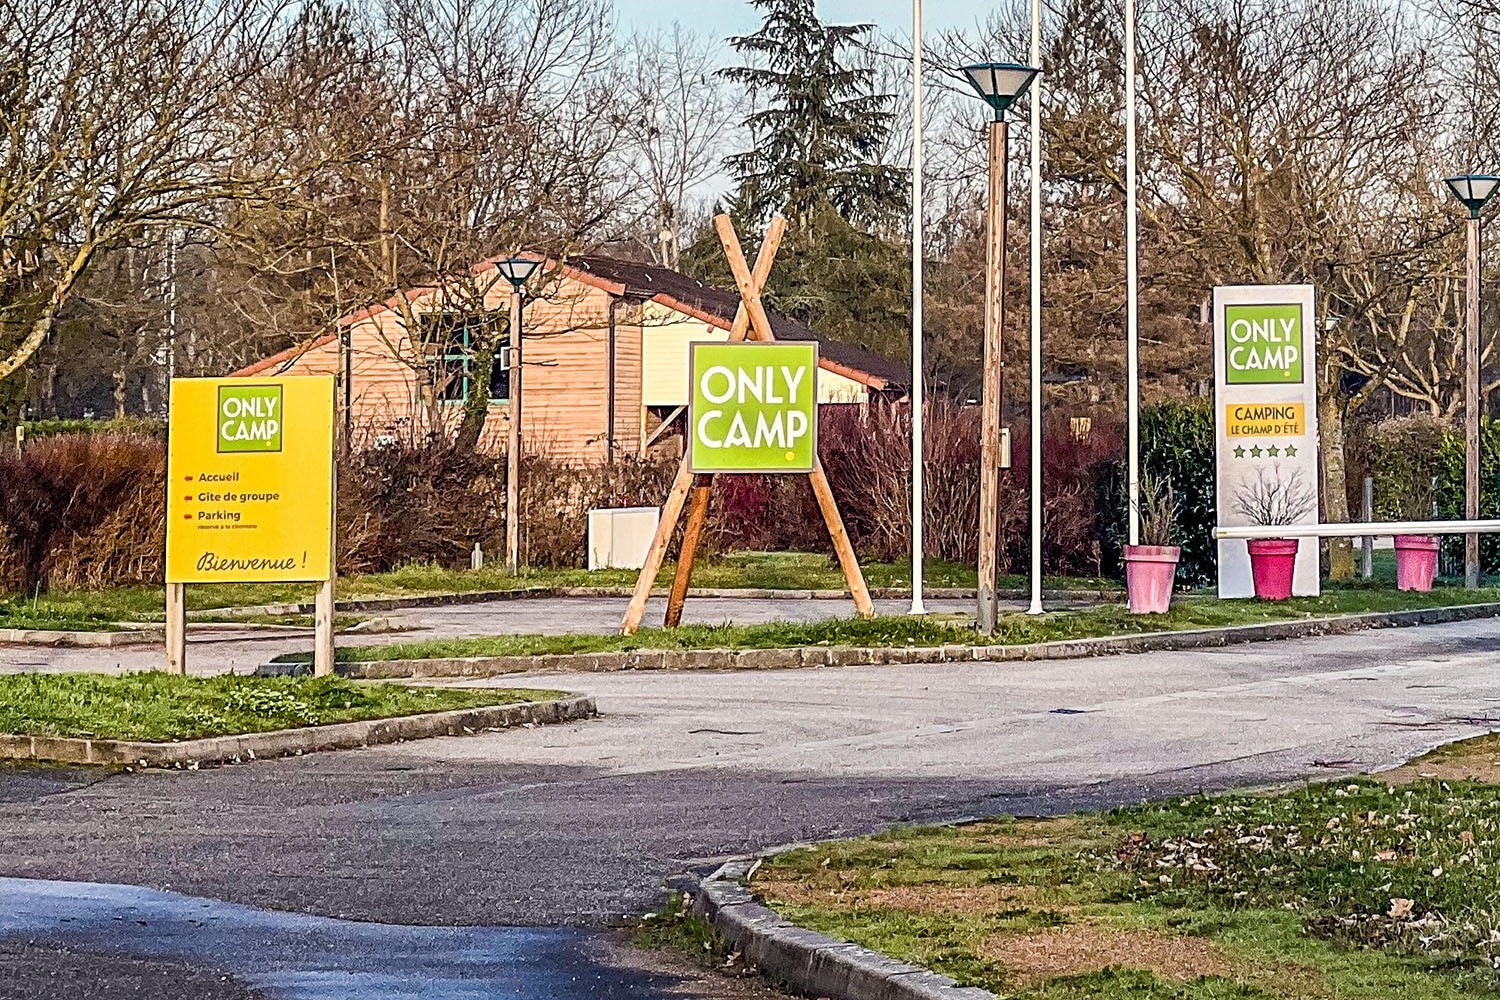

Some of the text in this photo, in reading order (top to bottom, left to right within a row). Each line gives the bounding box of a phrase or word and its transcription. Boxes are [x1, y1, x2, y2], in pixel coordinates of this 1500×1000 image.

[1230, 318, 1296, 343] ONLY
[1229, 345, 1298, 370] CAMP
[700, 365, 806, 404] ONLY
[222, 397, 278, 418] ONLY
[1235, 406, 1295, 421] CAMPING
[221, 419, 279, 441] CAMP
[697, 410, 808, 449] CAMP
[1231, 425, 1240, 434] LE
[1241, 425, 1273, 434] CHAMP
[198, 472, 239, 482] Accueil
[223, 492, 237, 501] de
[239, 492, 280, 503] groupe
[198, 510, 241, 522] Parking
[196, 551, 296, 572] Bienvenue
